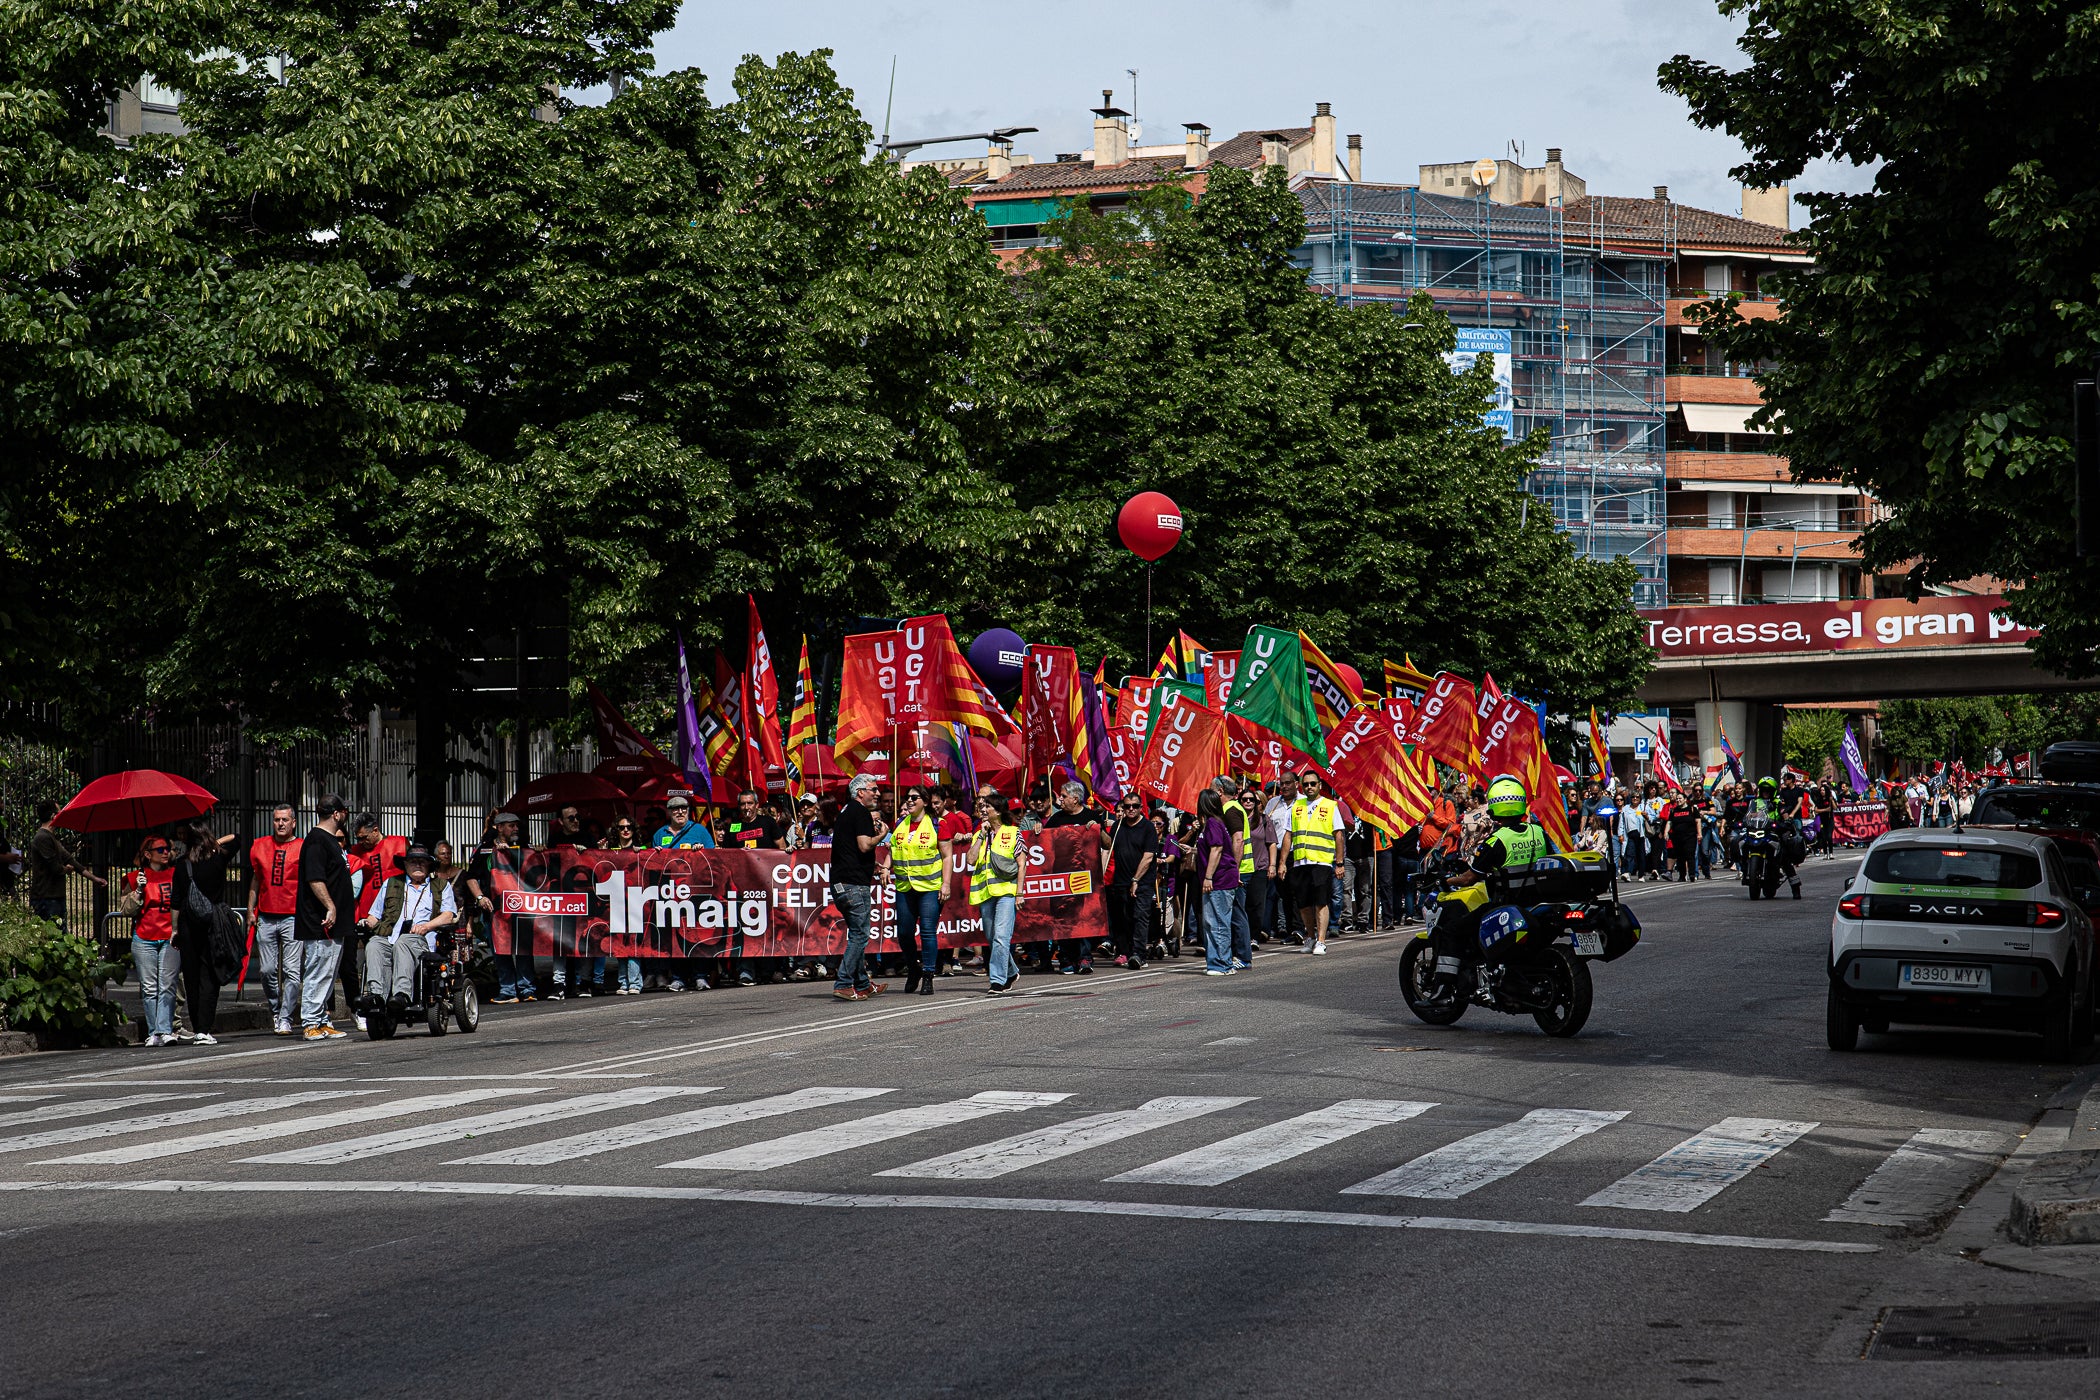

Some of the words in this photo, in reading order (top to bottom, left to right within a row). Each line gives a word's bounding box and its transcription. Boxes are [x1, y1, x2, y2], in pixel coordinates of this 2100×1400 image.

[1471, 342, 1504, 350] BASTIDES
[1647, 619, 1811, 645] Terrassa,
[1823, 611, 1862, 638] el
[1875, 612, 1975, 643] gran
[905, 626, 925, 702] UGT
[899, 703, 923, 713] .cat
[1419, 678, 1454, 733] UGT
[1483, 703, 1520, 754] UGT
[1158, 706, 1196, 780] UGT
[1329, 714, 1375, 766] UGT
[1408, 734, 1427, 744] .cat
[1637, 739, 1646, 752] P
[1148, 780, 1169, 793] .cat
[1023, 878, 1066, 893] COO
[595, 870, 660, 934] 1r
[660, 879, 691, 900] de
[743, 890, 767, 899] 2026
[773, 888, 779, 907] I
[786, 888, 817, 907] EL
[525, 896, 585, 913] UGT.cat
[1909, 904, 1984, 916] DACIA
[656, 890, 768, 937] maig
[1578, 934, 1597, 944] 9687
[1580, 944, 1596, 954] NDY
[1913, 967, 1949, 981] 8390
[1954, 969, 1983, 983] MYV
